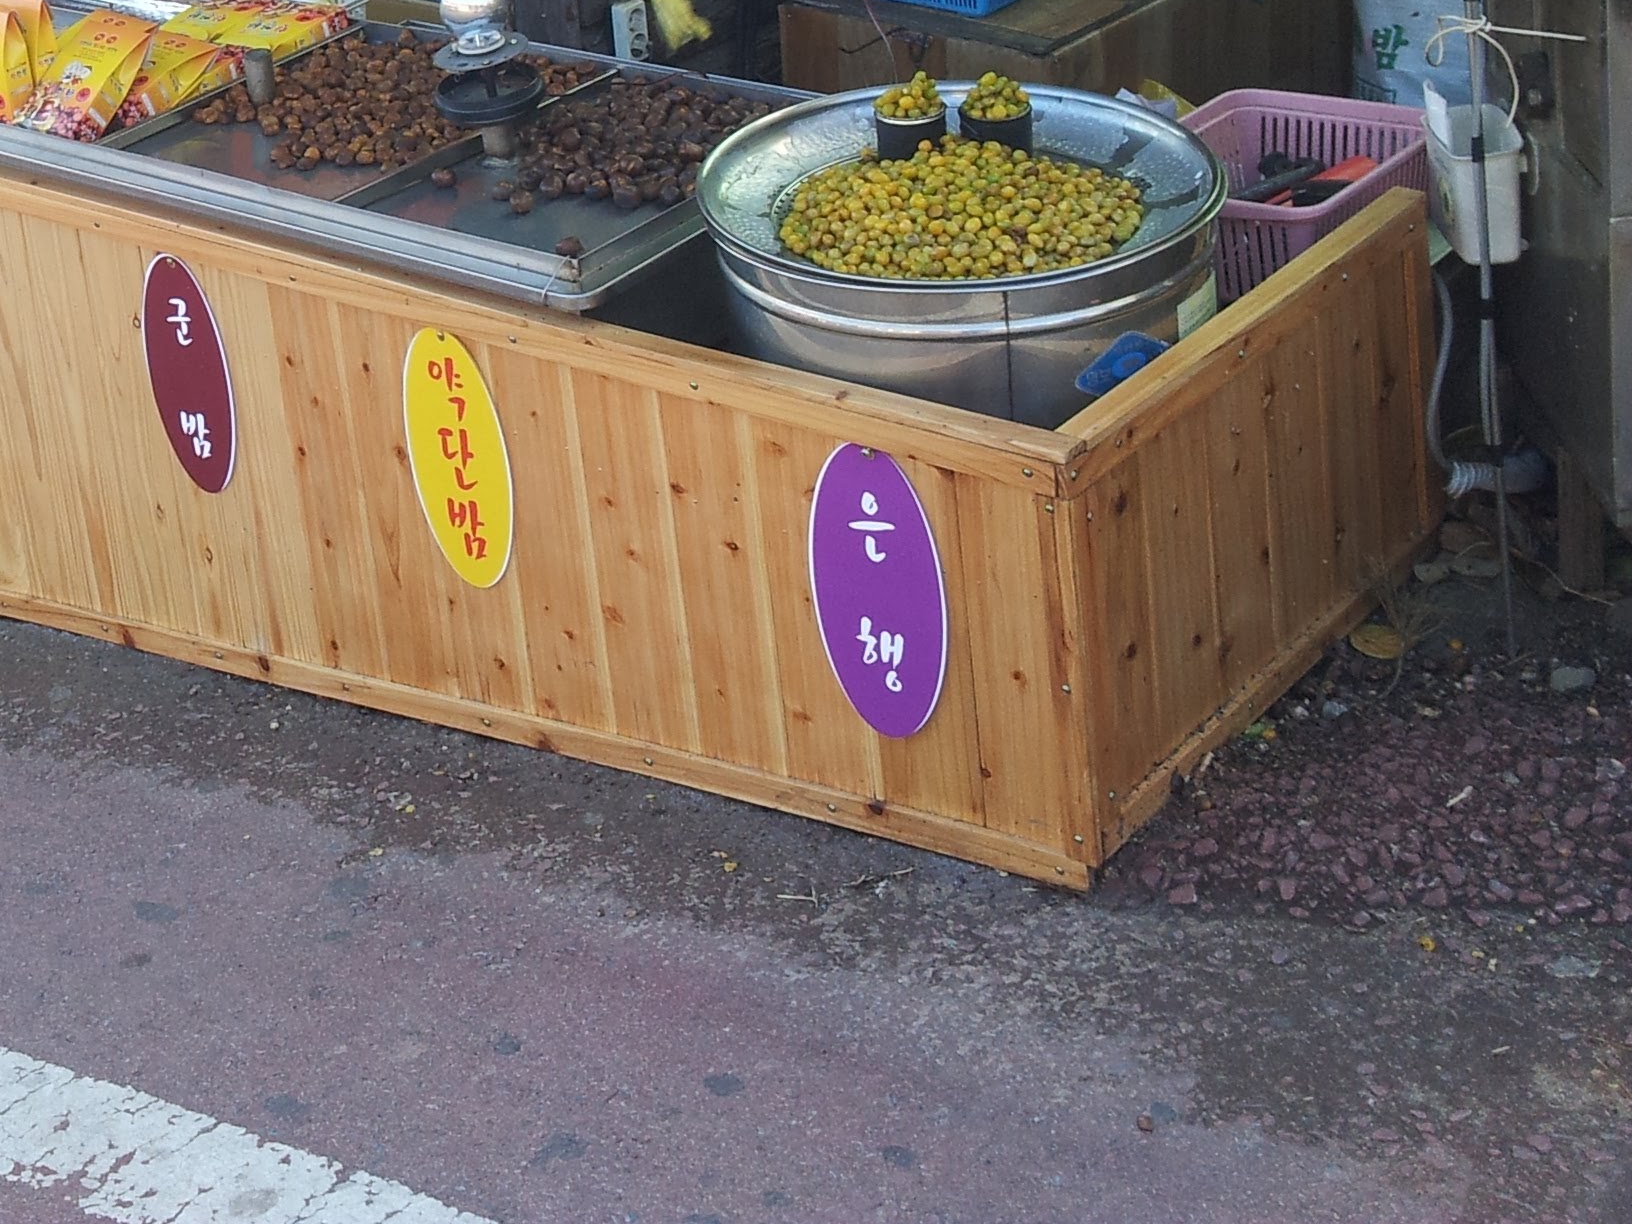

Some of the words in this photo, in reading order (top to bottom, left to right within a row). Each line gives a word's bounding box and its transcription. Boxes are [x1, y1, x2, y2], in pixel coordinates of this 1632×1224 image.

[166, 299, 212, 459] 군밤
[427, 356, 488, 562] 약단밤
[848, 490, 905, 694] 은행
